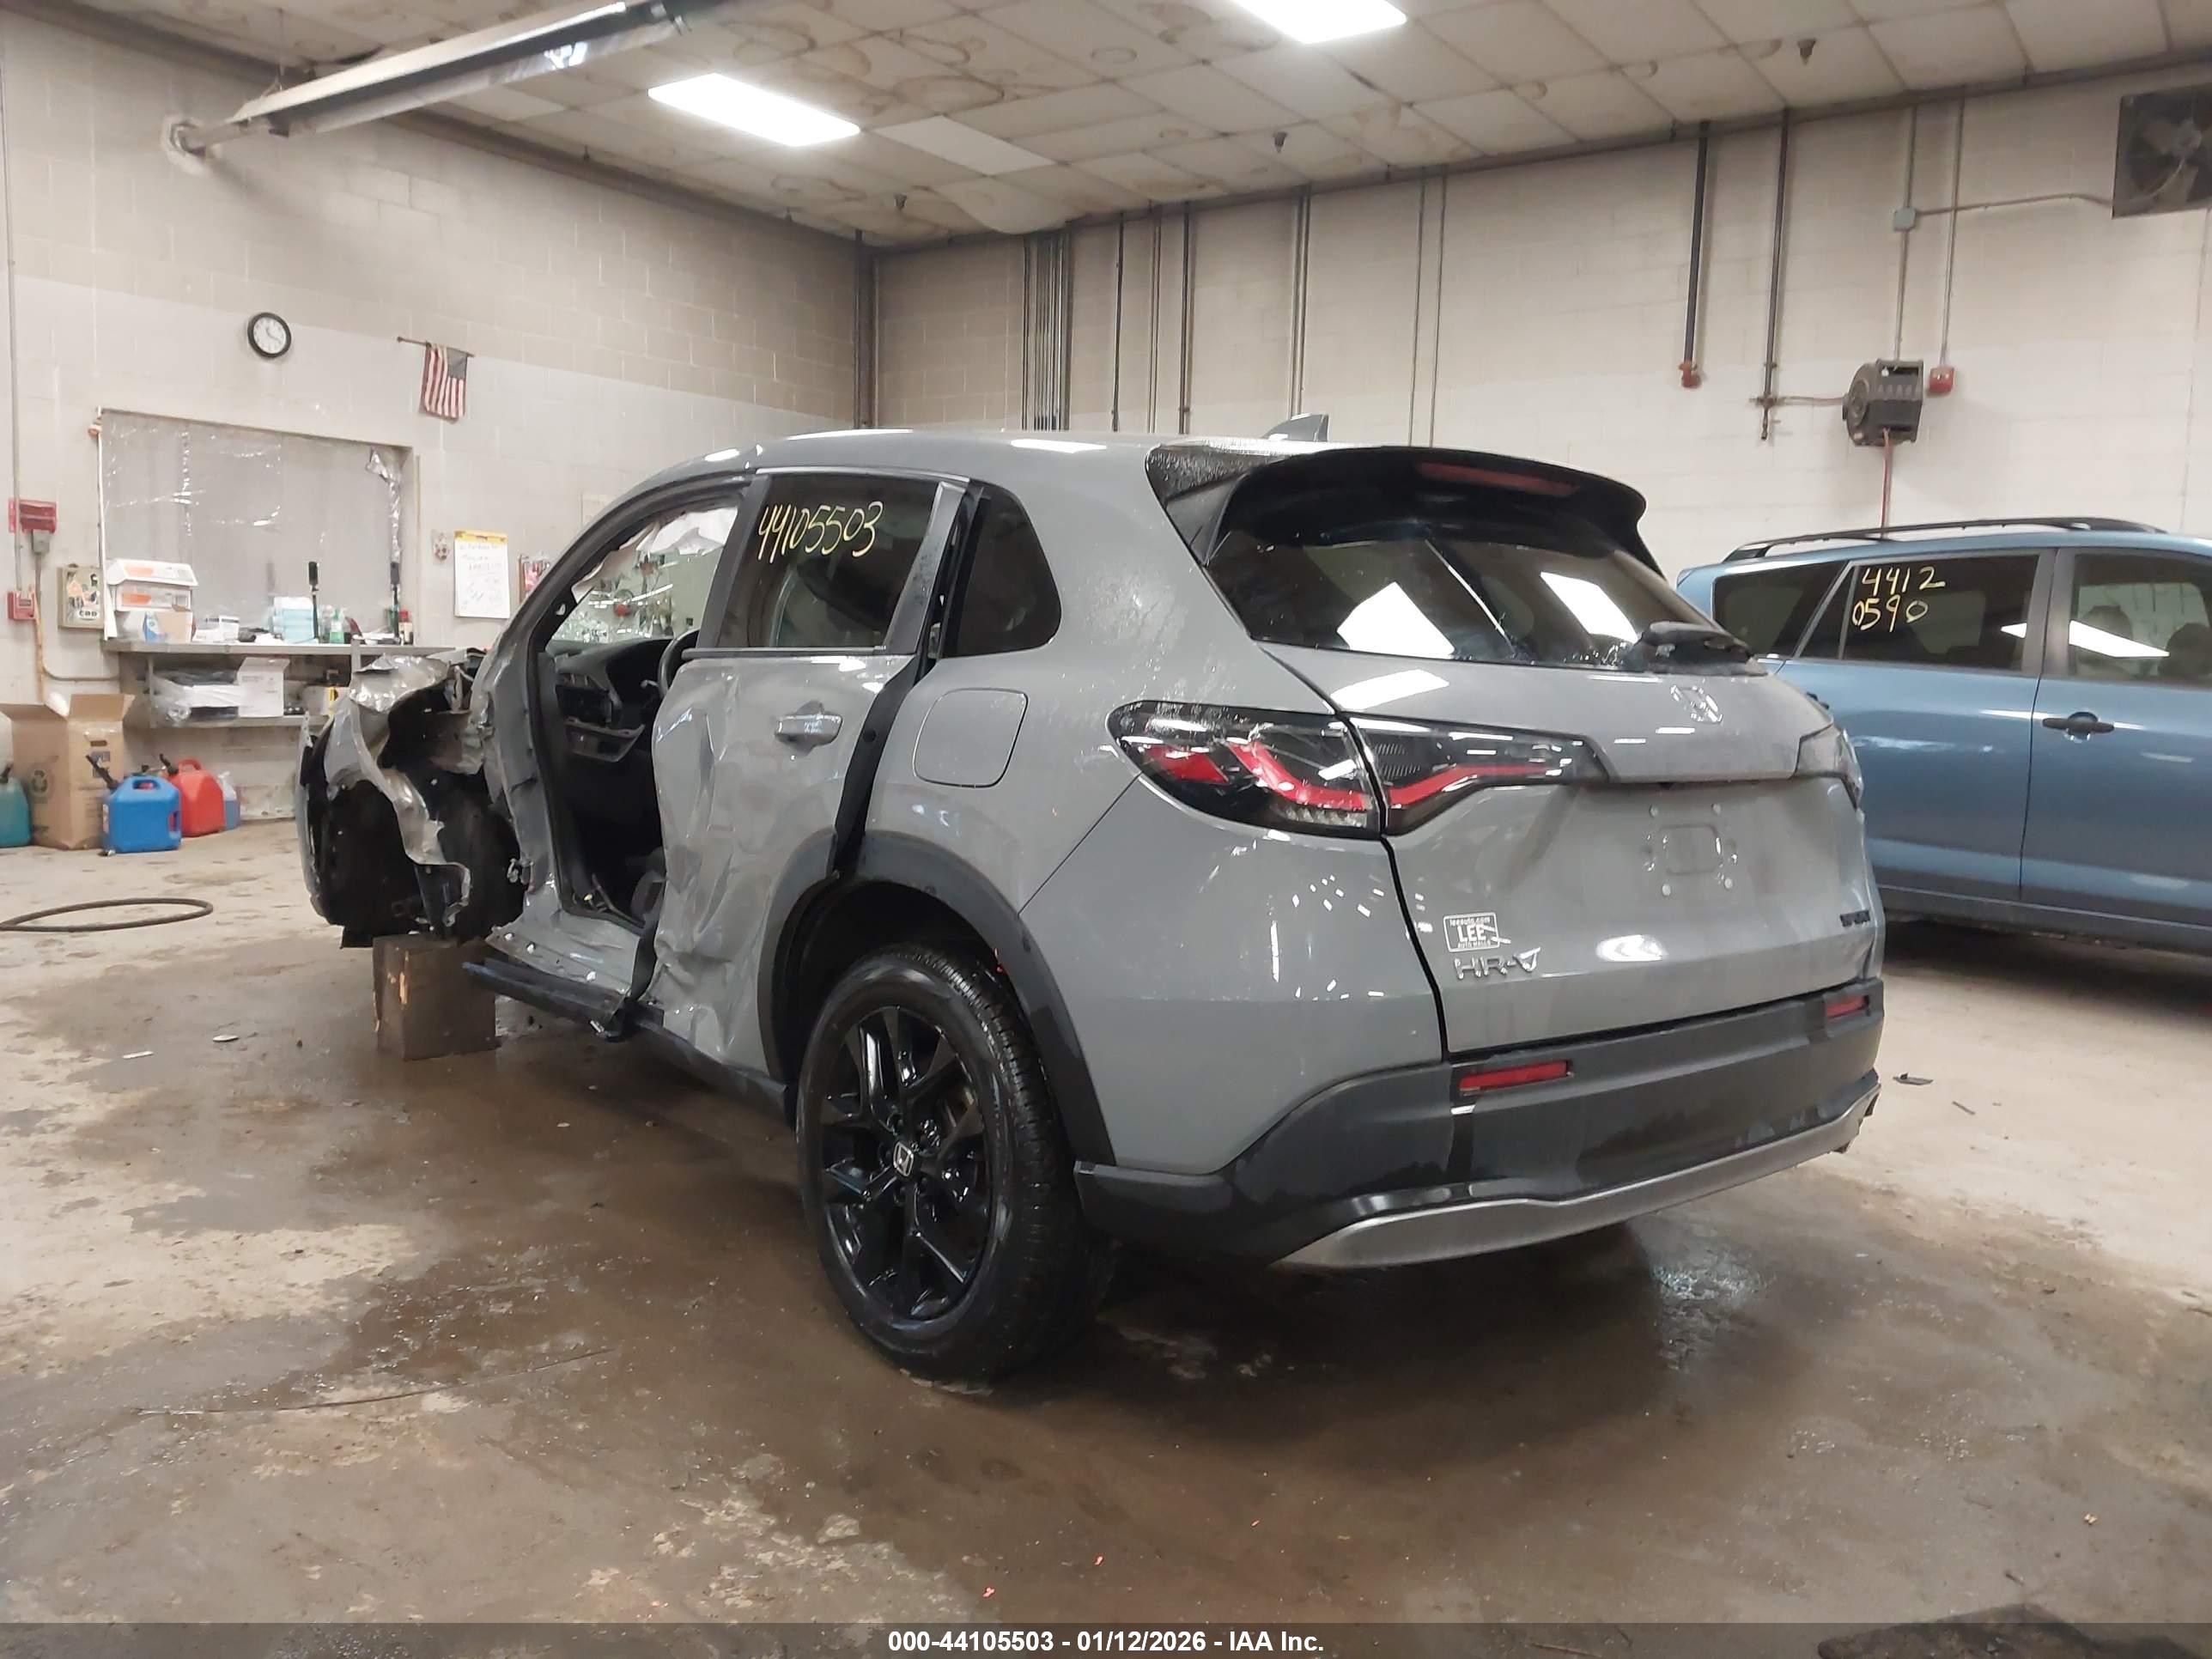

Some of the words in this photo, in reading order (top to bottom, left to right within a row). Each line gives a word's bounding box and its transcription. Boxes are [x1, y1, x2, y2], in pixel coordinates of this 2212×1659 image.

[757, 501, 884, 564] 44105503
[1862, 566, 1946, 596] 4412
[1851, 594, 1929, 633] 0590
[1456, 924, 1486, 942] LEE
[1454, 946, 1541, 980] HR-V
